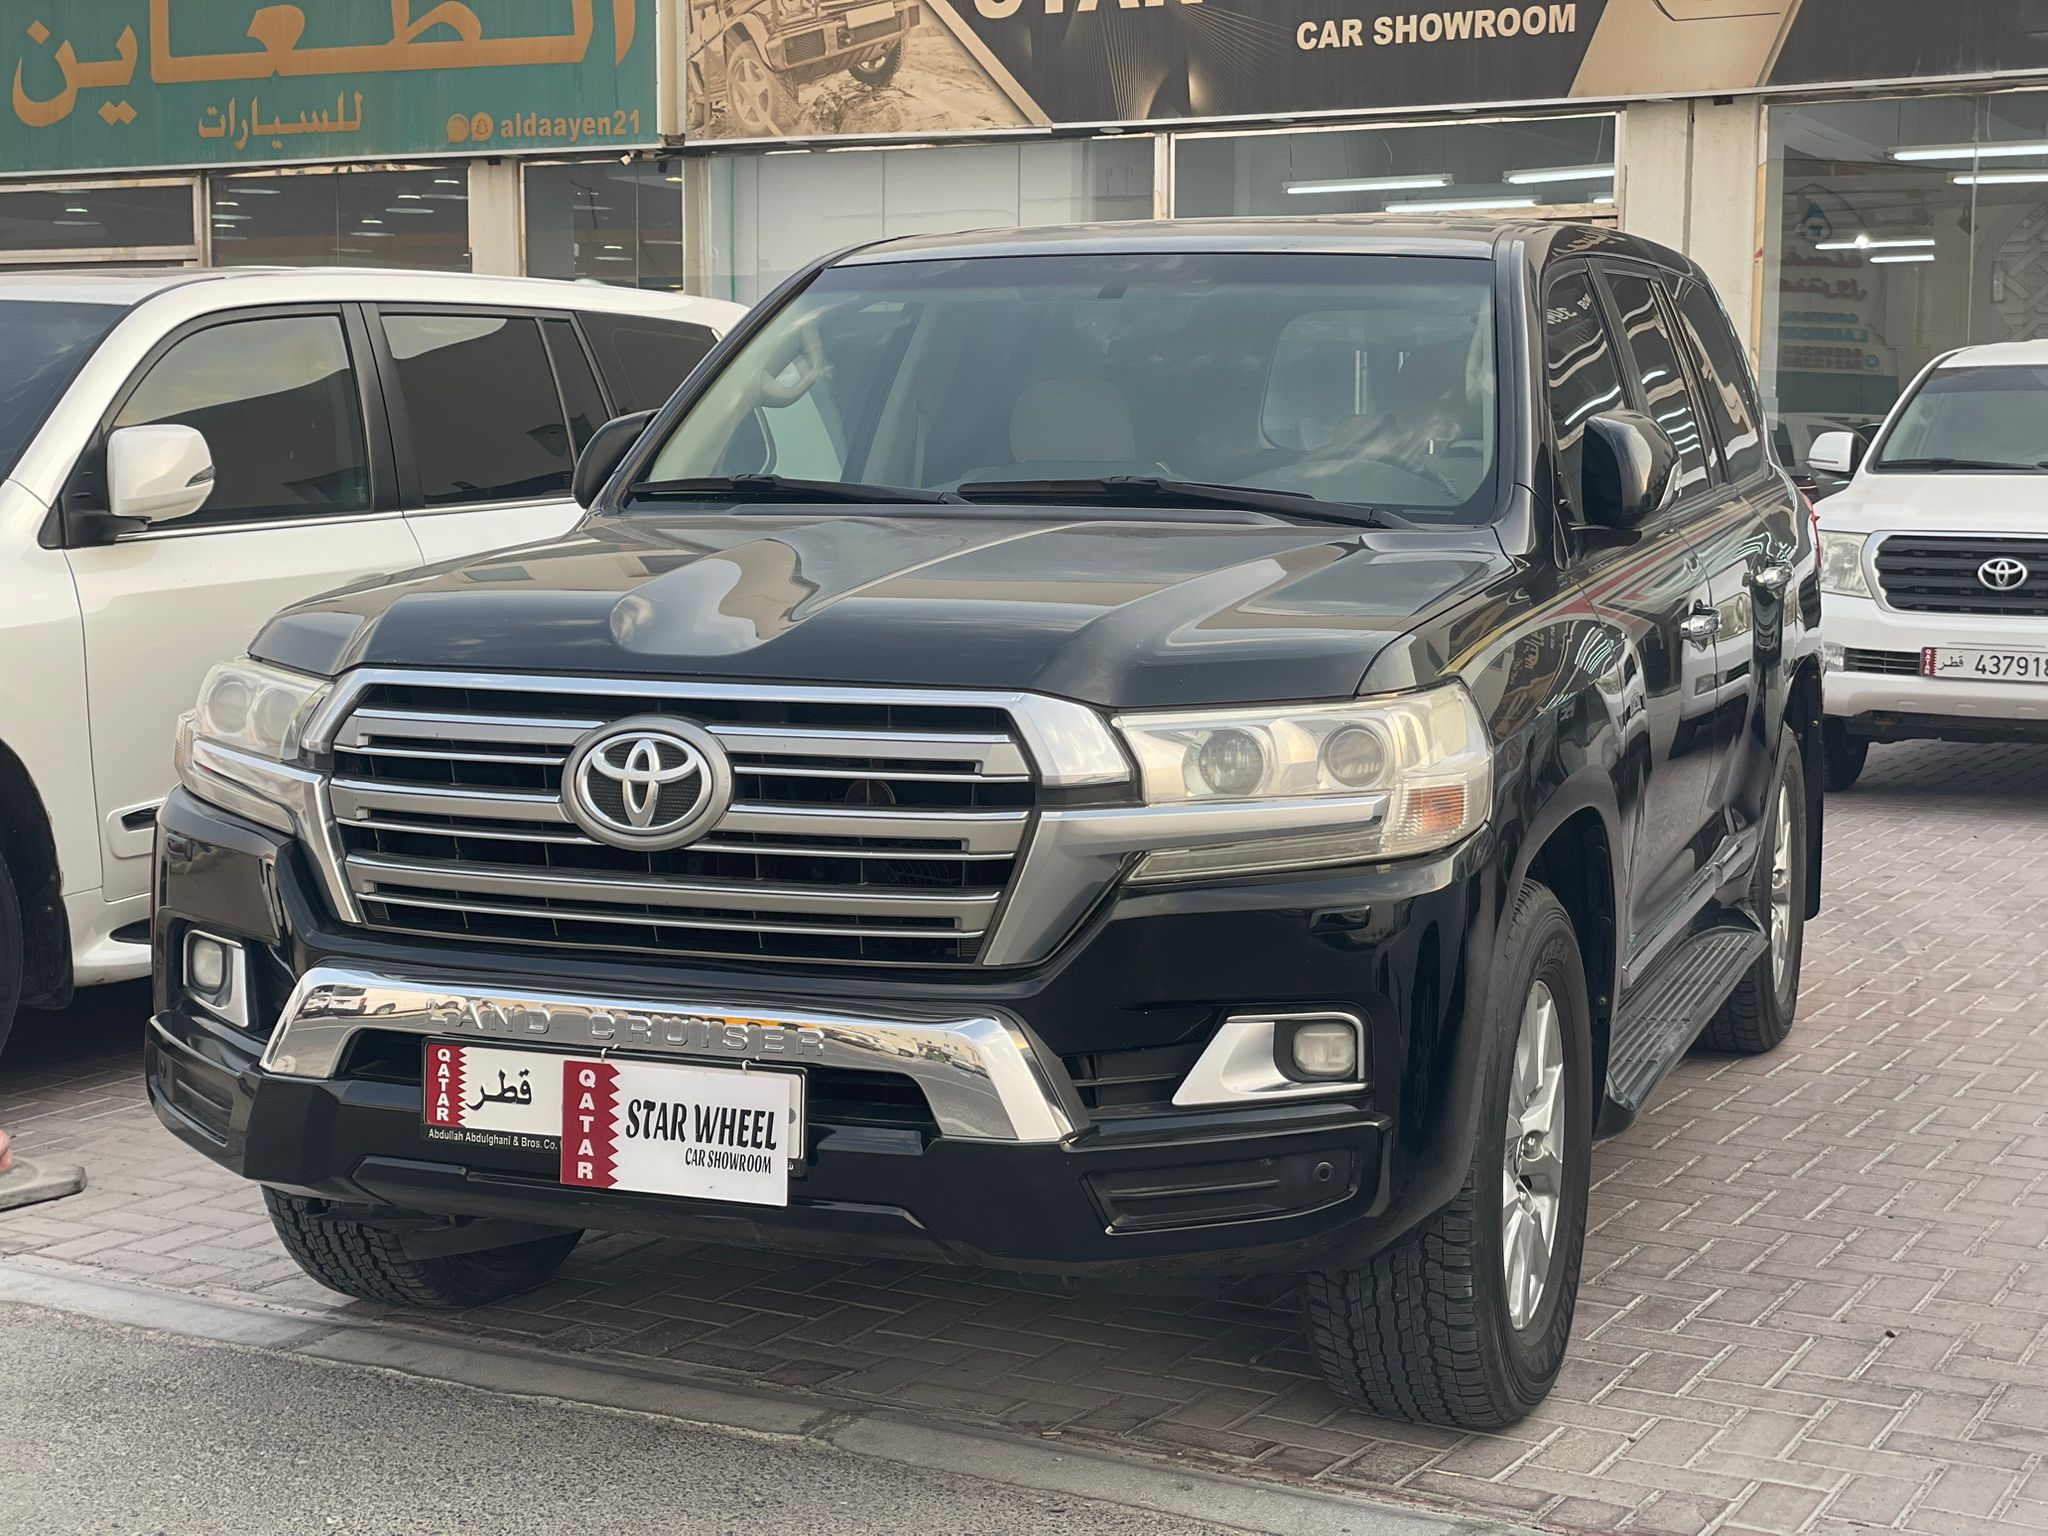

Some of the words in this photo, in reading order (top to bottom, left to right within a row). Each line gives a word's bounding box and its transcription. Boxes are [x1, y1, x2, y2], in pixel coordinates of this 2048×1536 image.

[1296, 20, 1363, 50] CAR
[1373, 3, 1576, 46] SHOWROOM
[198, 90, 363, 151] للسيارات
[500, 109, 640, 142] aldaayen21
[1936, 655, 1964, 671] قطر
[426, 999, 551, 1034] LAND
[588, 1011, 824, 1056] CRUISER
[436, 1048, 451, 1122] QATAR
[465, 1068, 532, 1111] قطر
[428, 1128, 464, 1142] Abdullah
[465, 1131, 511, 1146] Abdulghani
[513, 1136, 519, 1147] &
[577, 1069, 596, 1180] QATAR
[625, 1099, 687, 1143] STAR
[695, 1103, 776, 1150] WHEEL
[685, 1148, 706, 1167] CAR
[707, 1150, 771, 1174] SHOWROOM
